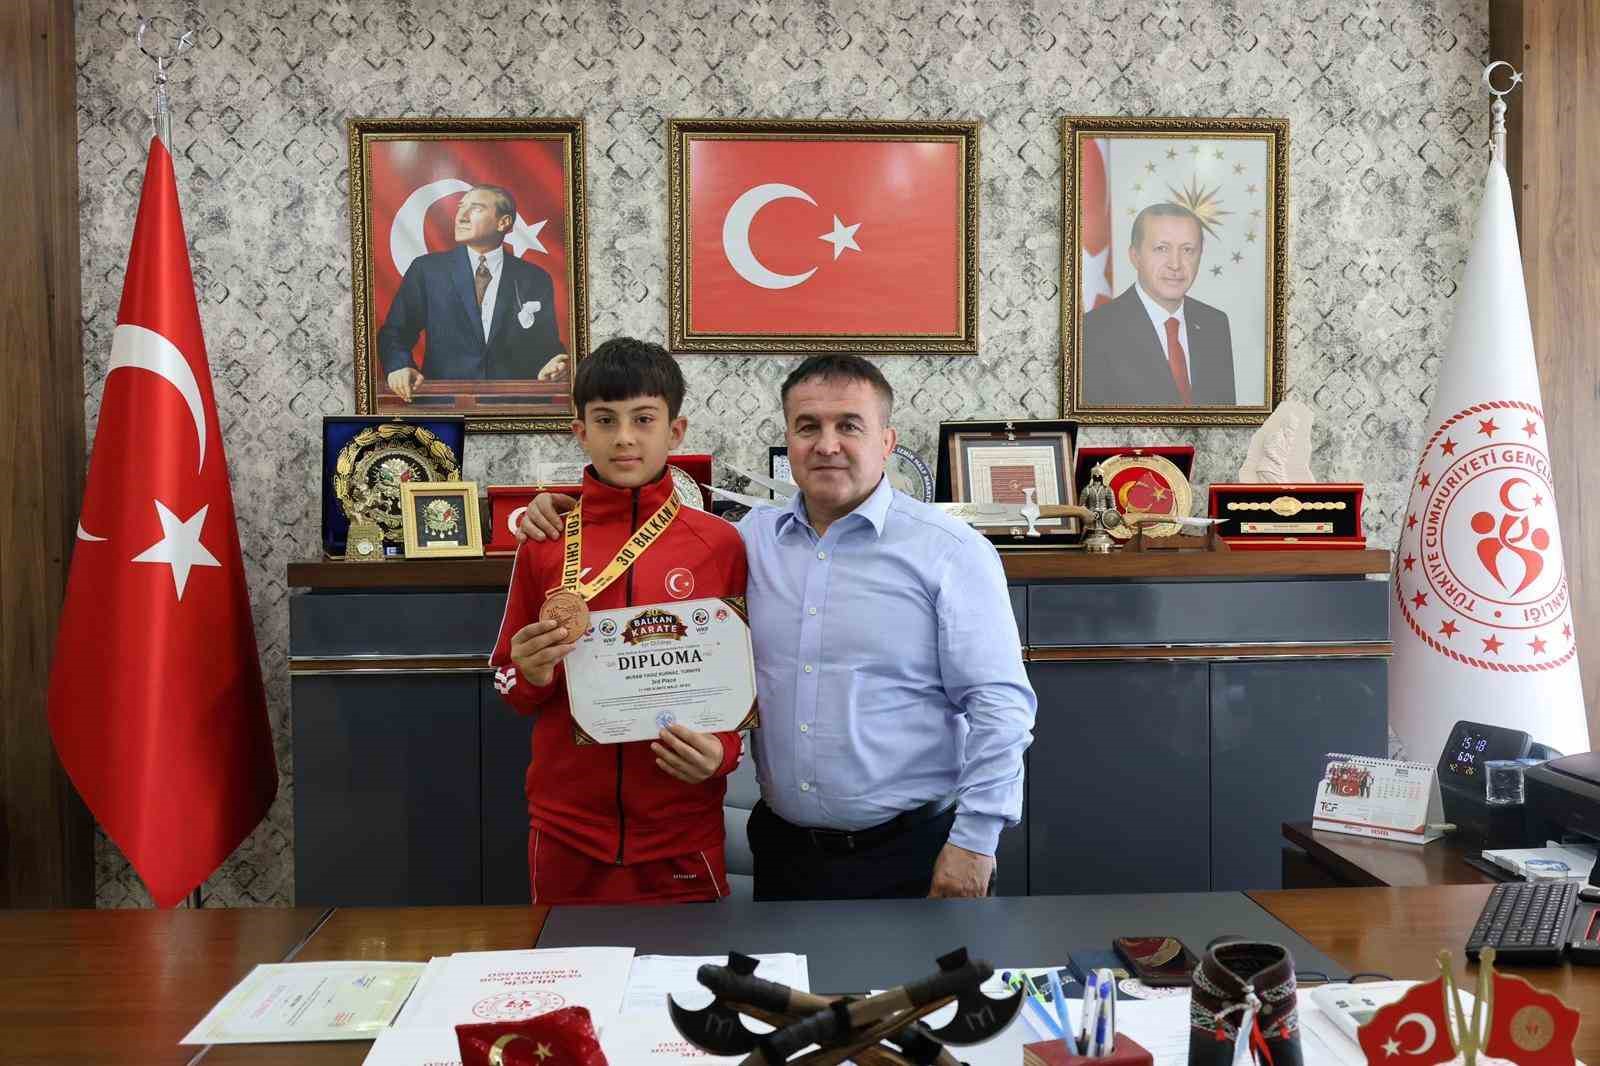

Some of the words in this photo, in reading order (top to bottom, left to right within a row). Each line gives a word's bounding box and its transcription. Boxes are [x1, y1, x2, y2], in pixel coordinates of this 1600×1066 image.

[1502, 449, 1553, 488] GENÇLİ
[1425, 448, 1497, 548] CUMHURİYETİ
[567, 513, 580, 538] FOR
[632, 506, 674, 548] BALKAN
[564, 542, 580, 591] CHILDRE
[1427, 551, 1475, 612] TÜRKİYE
[1523, 580, 1568, 622] KANLIĞI
[631, 625, 678, 638] KARATE
[633, 616, 673, 627] BALKAN
[618, 649, 703, 671] DIPLOMA
